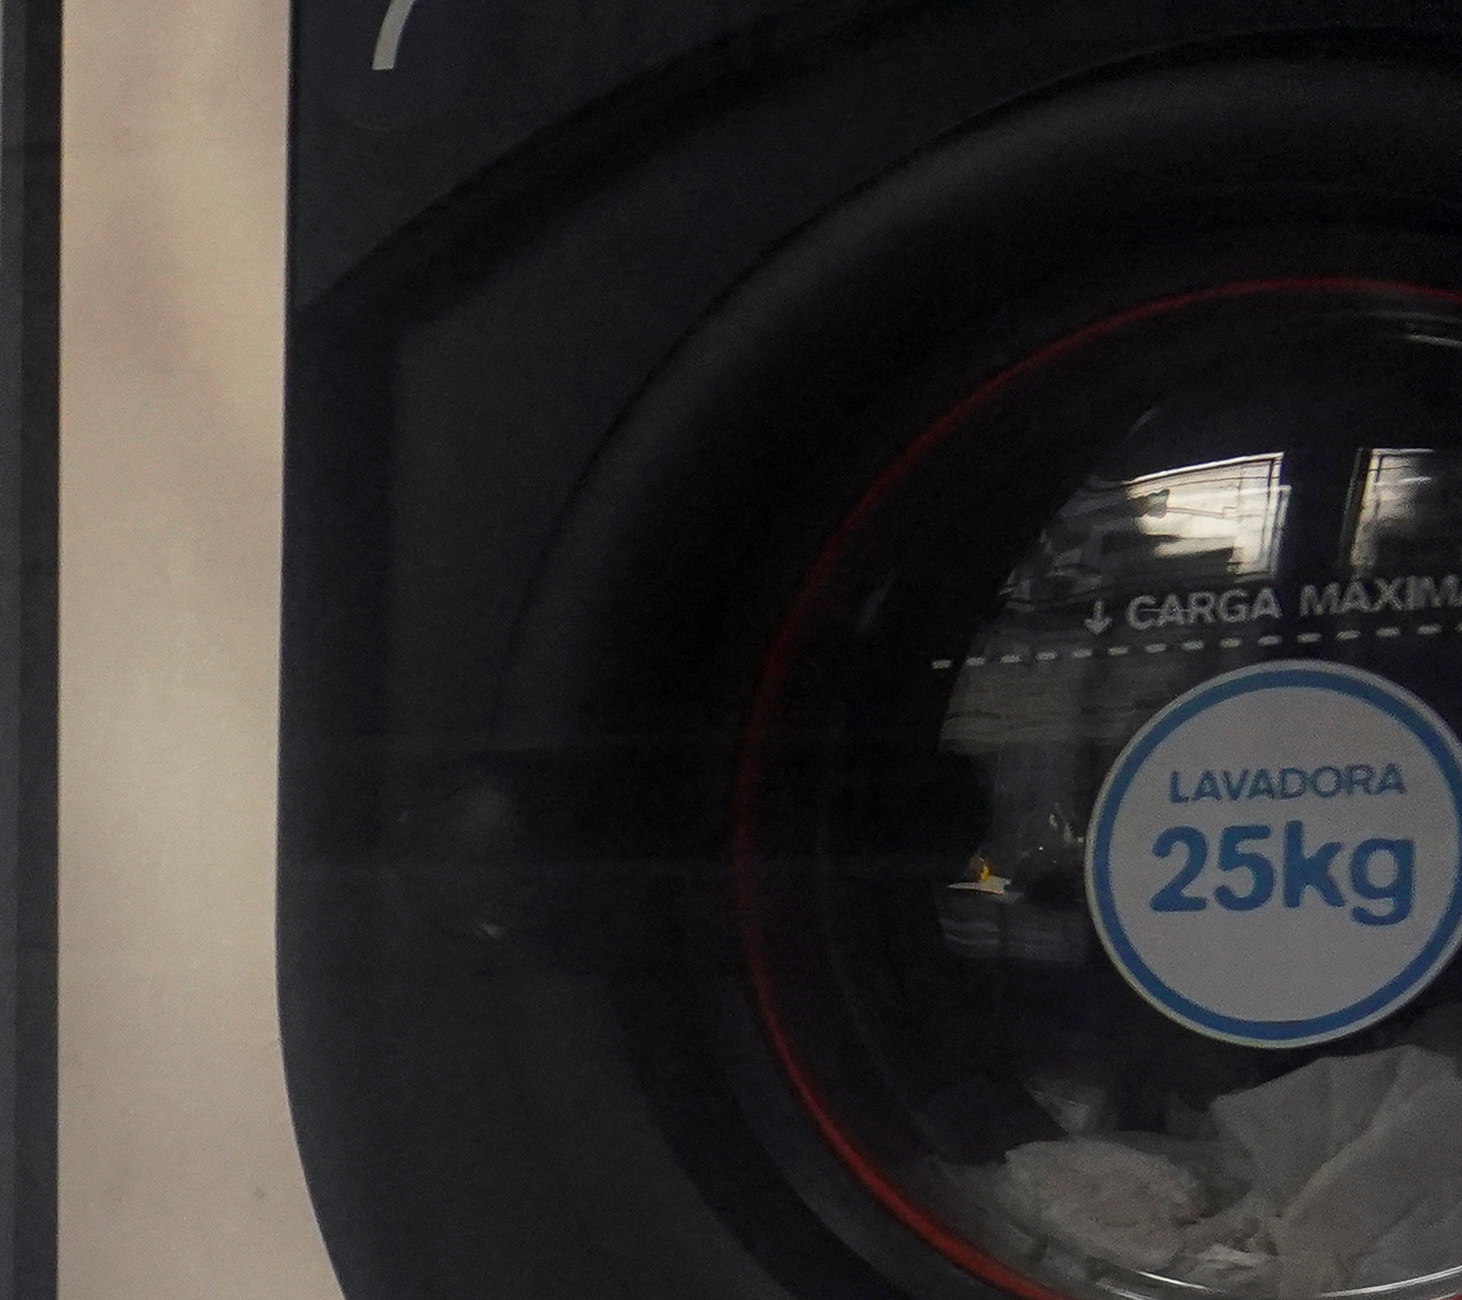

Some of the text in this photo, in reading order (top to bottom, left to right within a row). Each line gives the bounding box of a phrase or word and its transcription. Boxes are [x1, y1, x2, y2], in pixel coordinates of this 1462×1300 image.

[1126, 586, 1283, 631] CARGA
[1169, 762, 1408, 804] LAVADORA
[1150, 819, 1416, 926] 25kg
